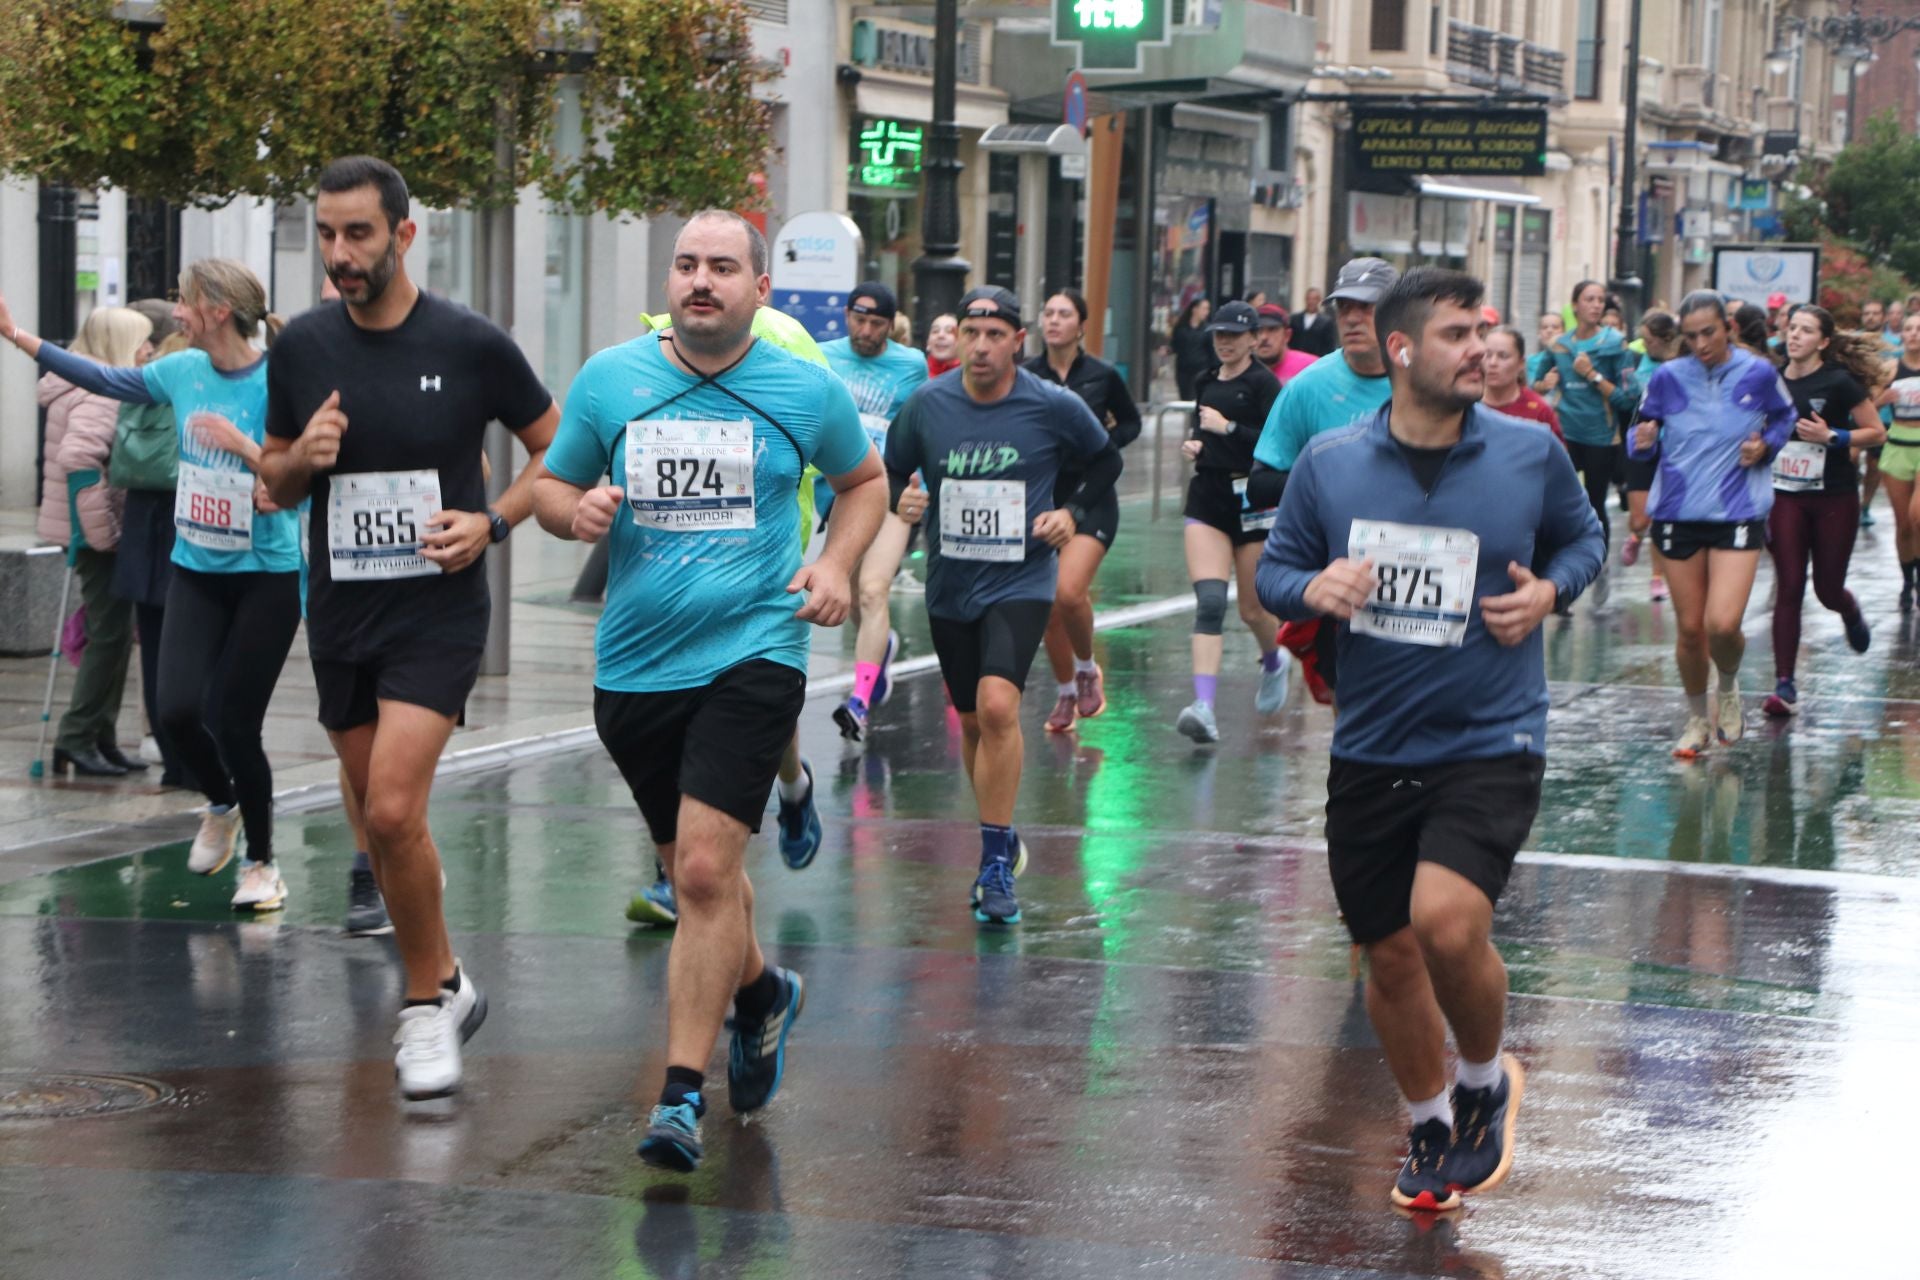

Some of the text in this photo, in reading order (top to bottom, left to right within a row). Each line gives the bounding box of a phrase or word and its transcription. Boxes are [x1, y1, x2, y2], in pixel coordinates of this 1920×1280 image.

[1361, 138, 1536, 152] APARATOS PARA SORDOS
[1371, 156, 1523, 170] LENTES DE CONTACTO
[651, 446, 727, 456] PRIMO DE IRENE
[947, 447, 1019, 476] WILD
[656, 458, 724, 497] 824
[1781, 456, 1811, 477] 1147
[191, 493, 232, 527] 668
[676, 511, 734, 521] HYUNDAI
[962, 508, 999, 536] 931
[353, 508, 417, 546] 855
[1376, 563, 1443, 608] 875
